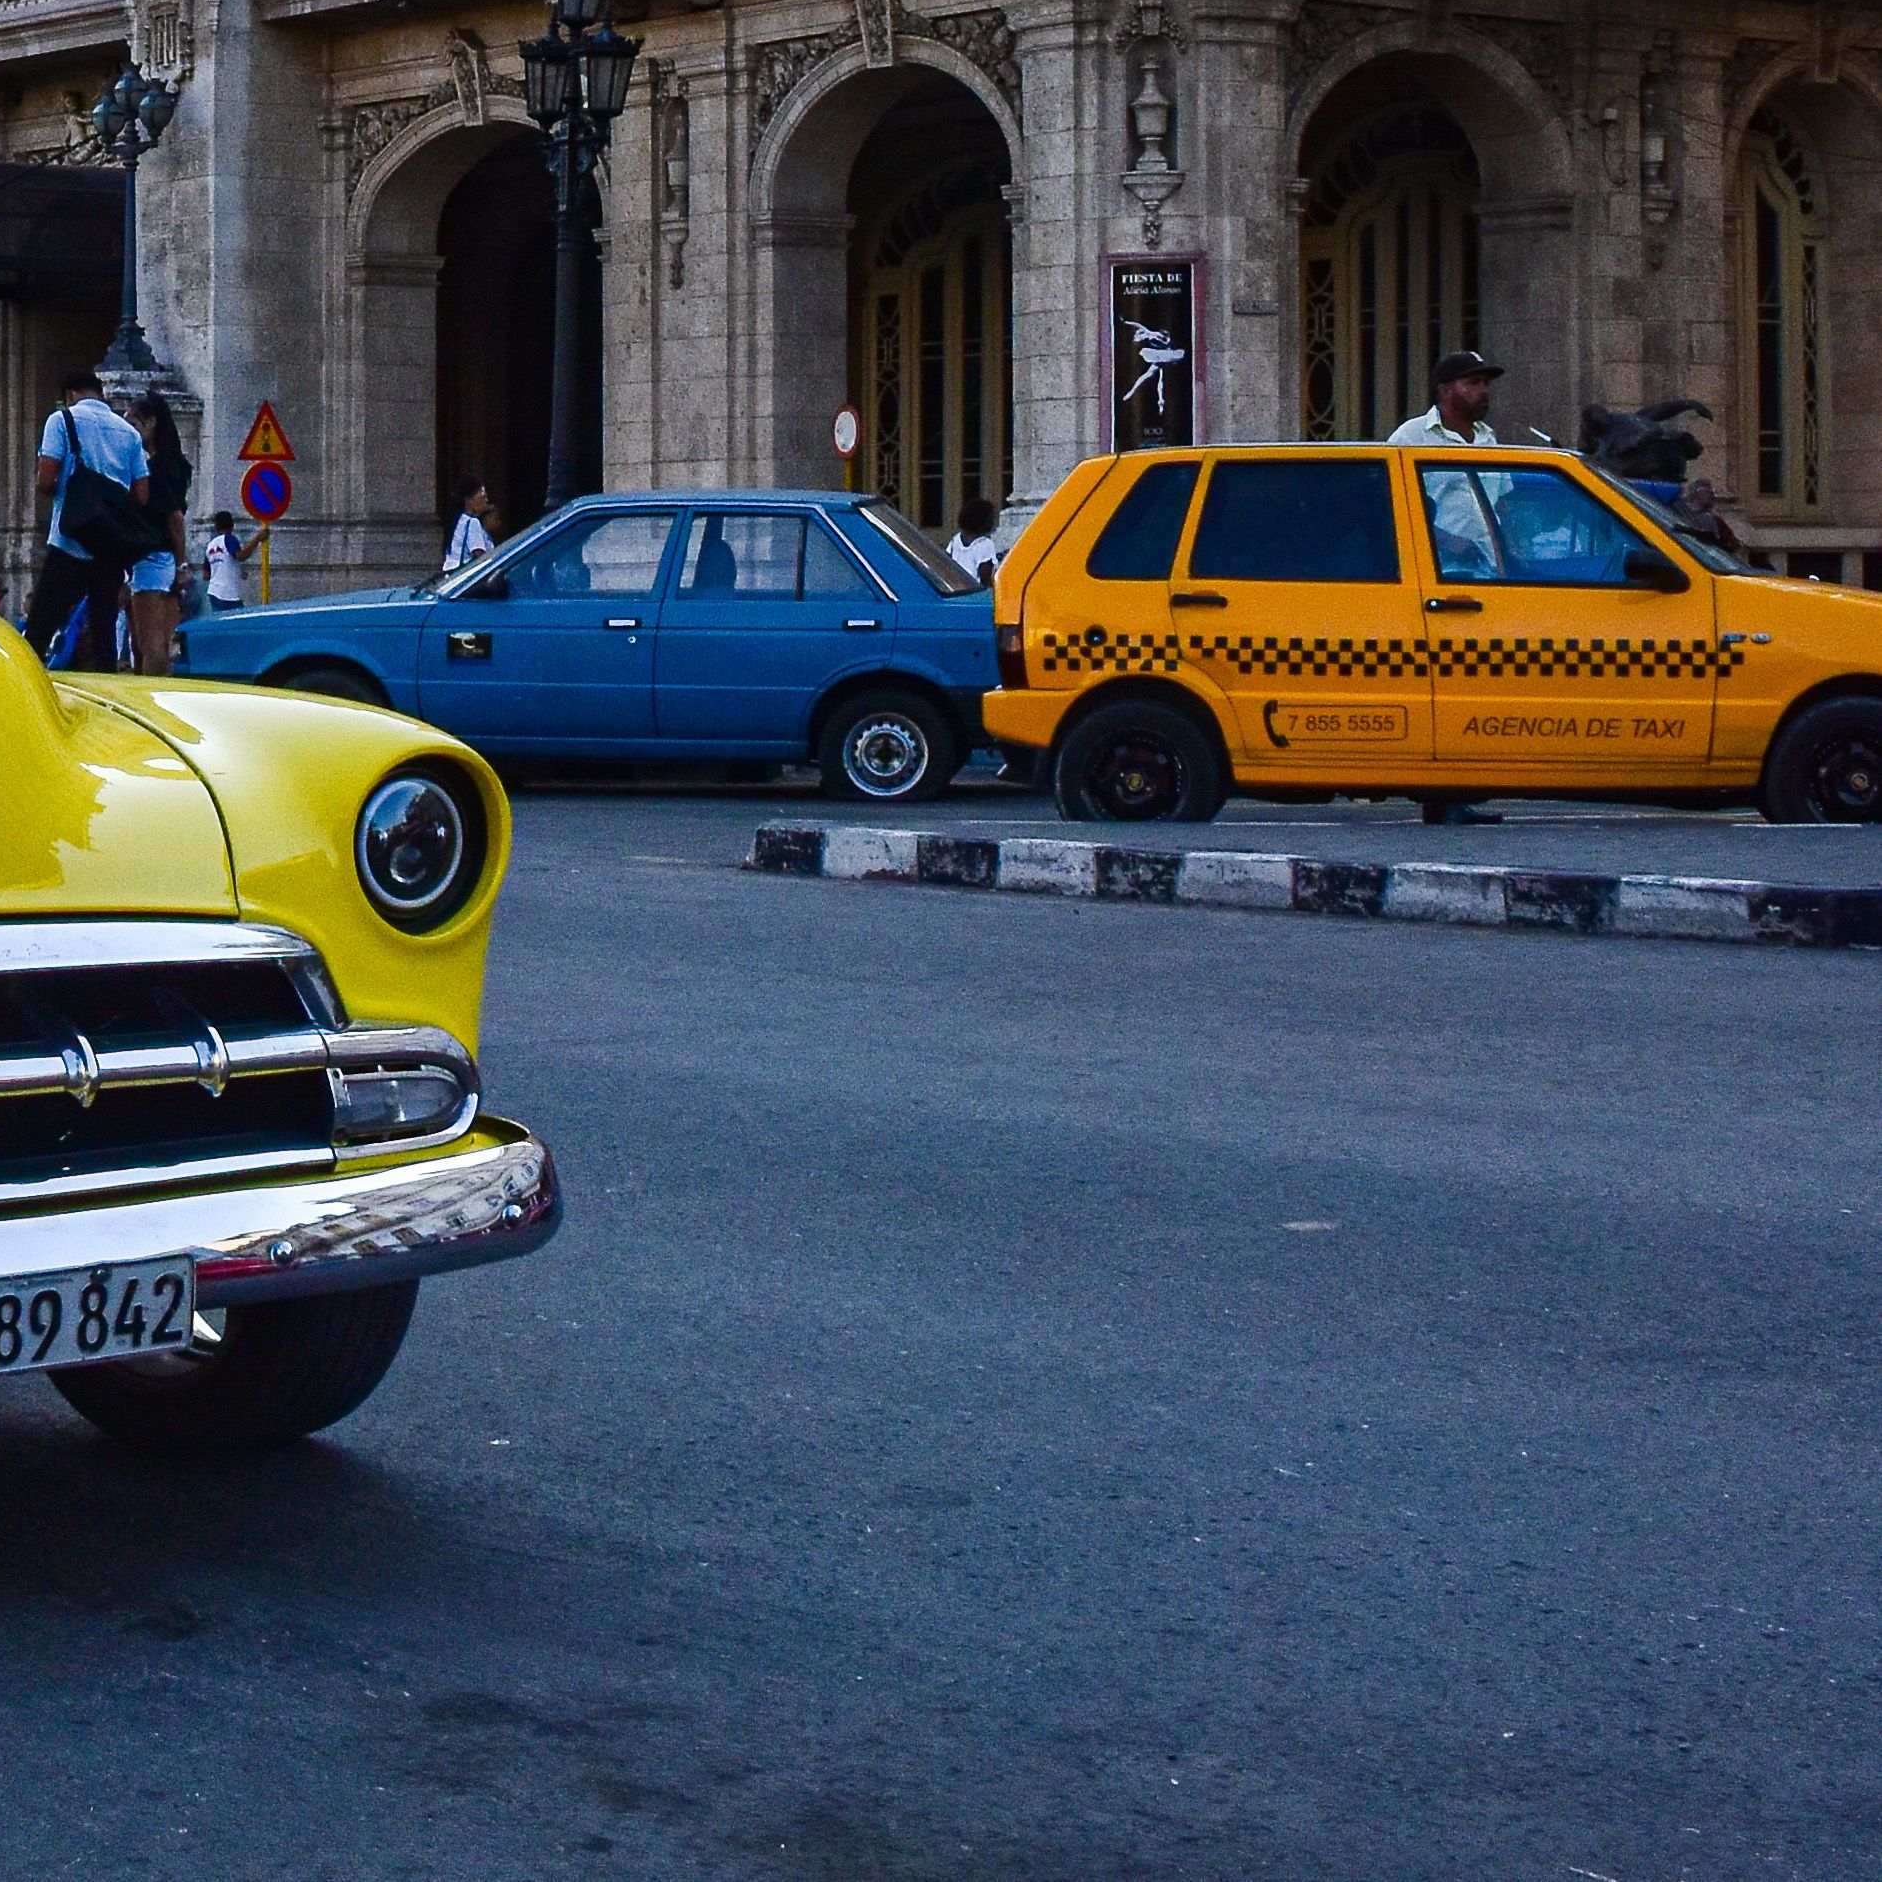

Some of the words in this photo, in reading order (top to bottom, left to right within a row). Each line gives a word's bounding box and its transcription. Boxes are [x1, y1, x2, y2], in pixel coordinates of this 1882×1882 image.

[1121, 273, 1163, 284] FIESTA
[1167, 273, 1183, 282] DE
[1288, 715, 1299, 731] 7
[1305, 715, 1341, 732] 855
[1348, 715, 1395, 732] 5555
[1463, 716, 1578, 737] AGENCIA
[1585, 718, 1622, 738] DE
[1631, 718, 1686, 739] TAXI
[77, 1271, 184, 1353] 842
